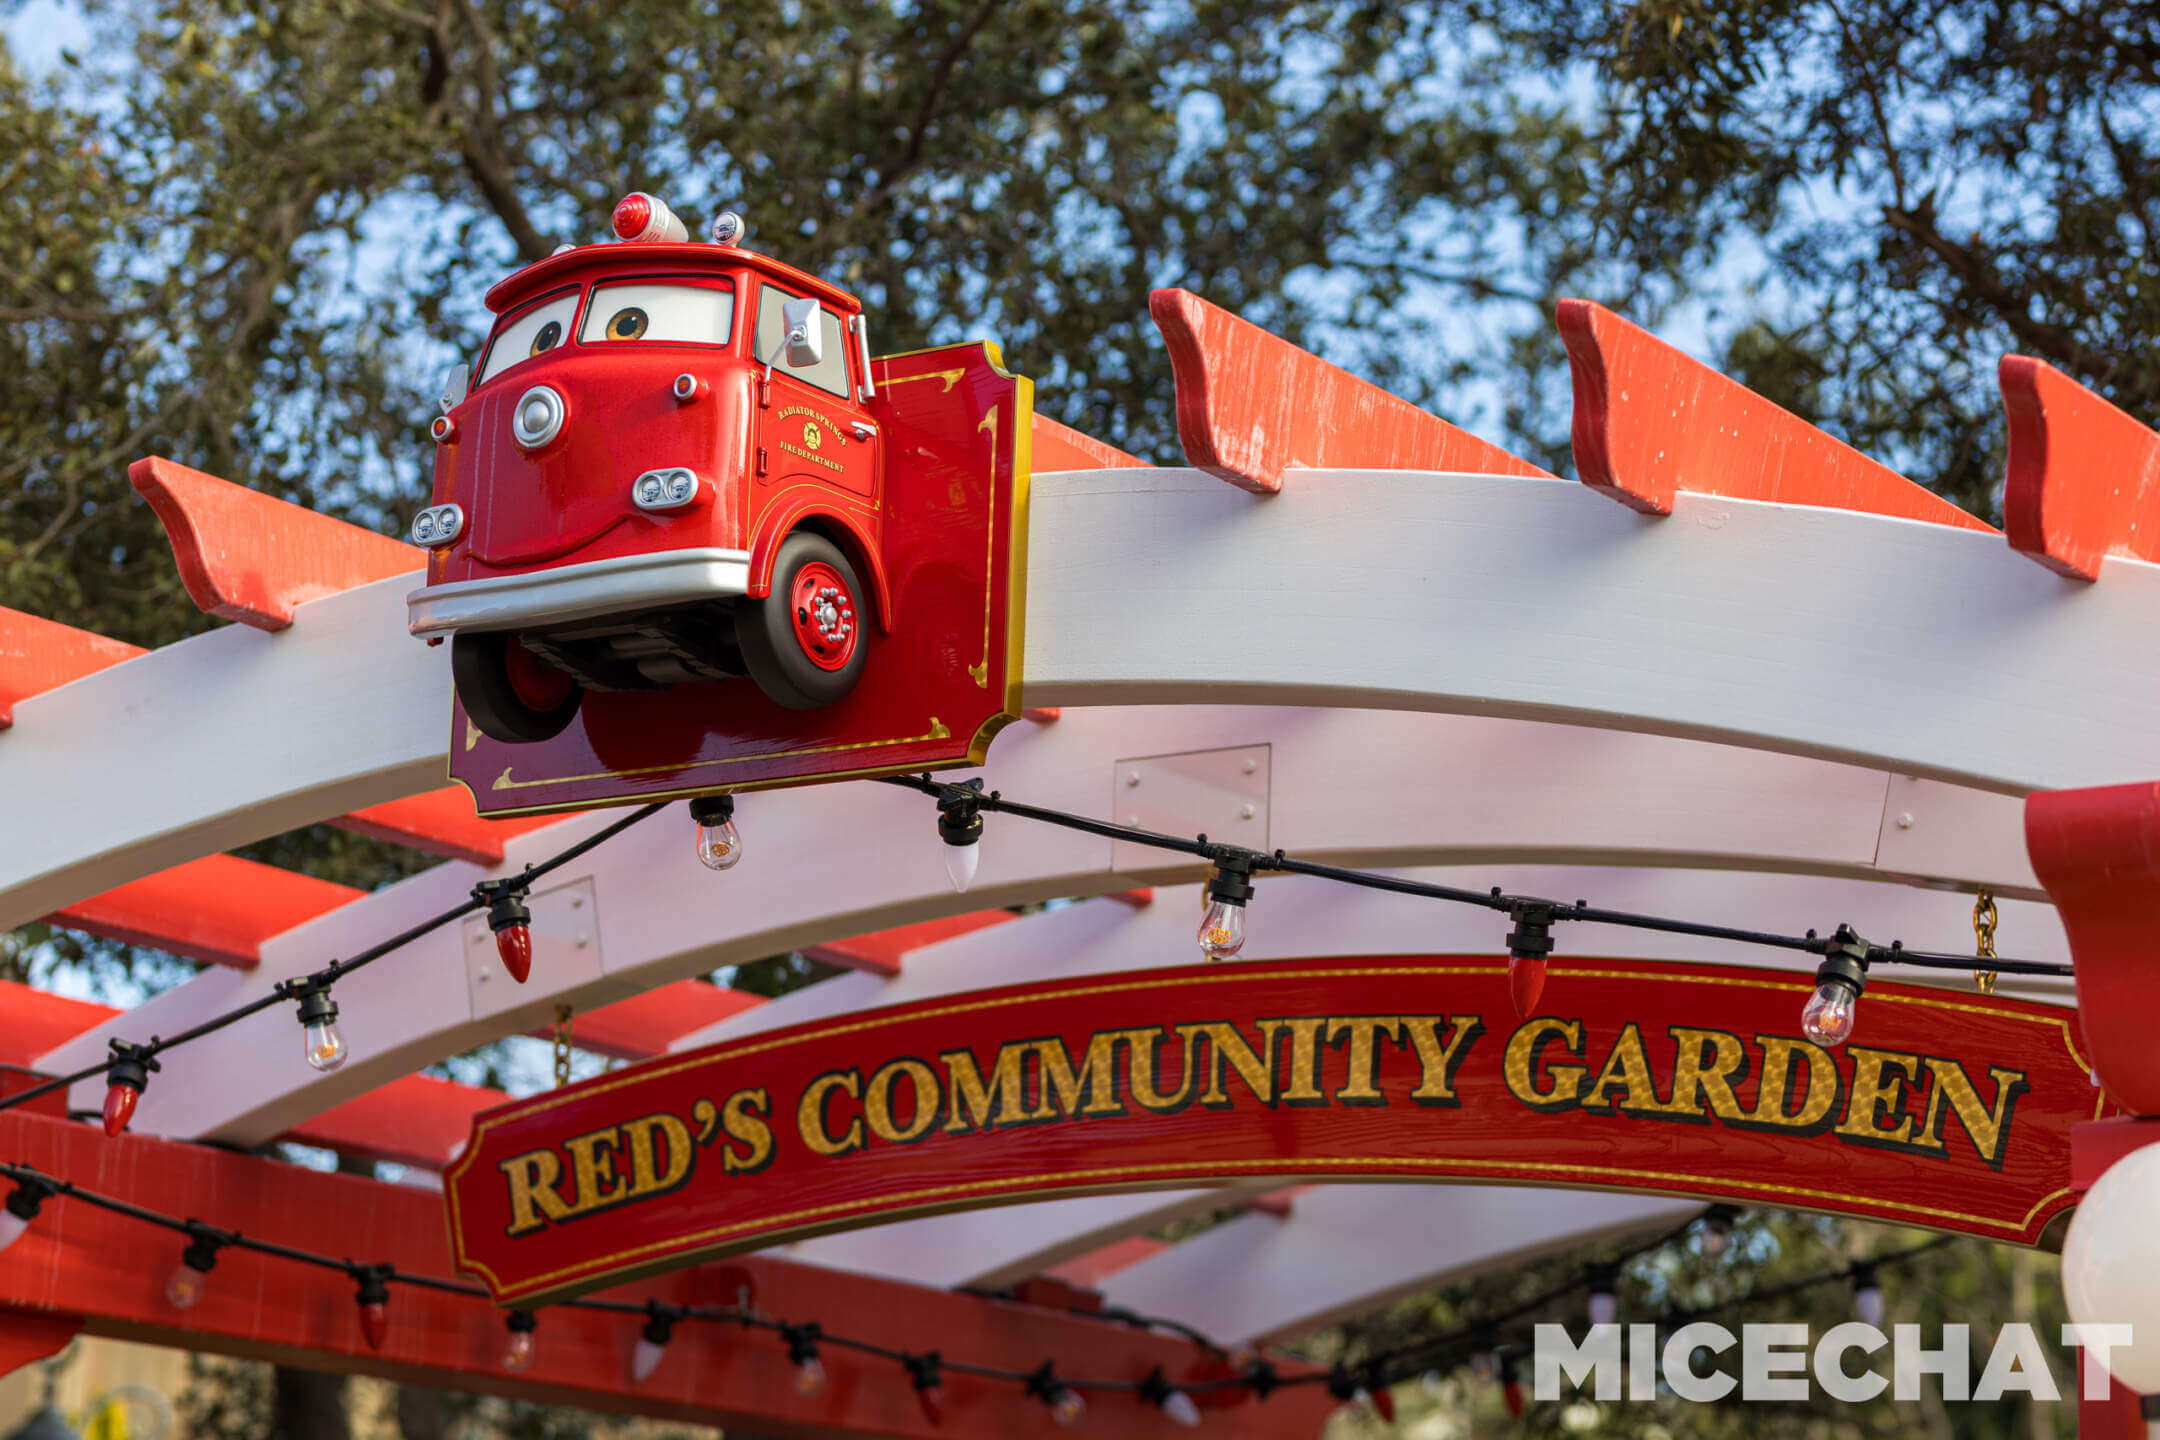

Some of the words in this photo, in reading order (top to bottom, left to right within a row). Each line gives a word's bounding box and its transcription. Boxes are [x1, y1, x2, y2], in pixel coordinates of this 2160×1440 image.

[778, 405, 815, 420] RADIATOR
[815, 412, 847, 447] SPRINGS
[780, 440, 797, 454] FIRE
[797, 448, 844, 473] DEPARTMENT
[501, 1088, 776, 1237] RED'S
[798, 1015, 1483, 1156] COMMUNITY
[1503, 1016, 2029, 1171] GARDEN
